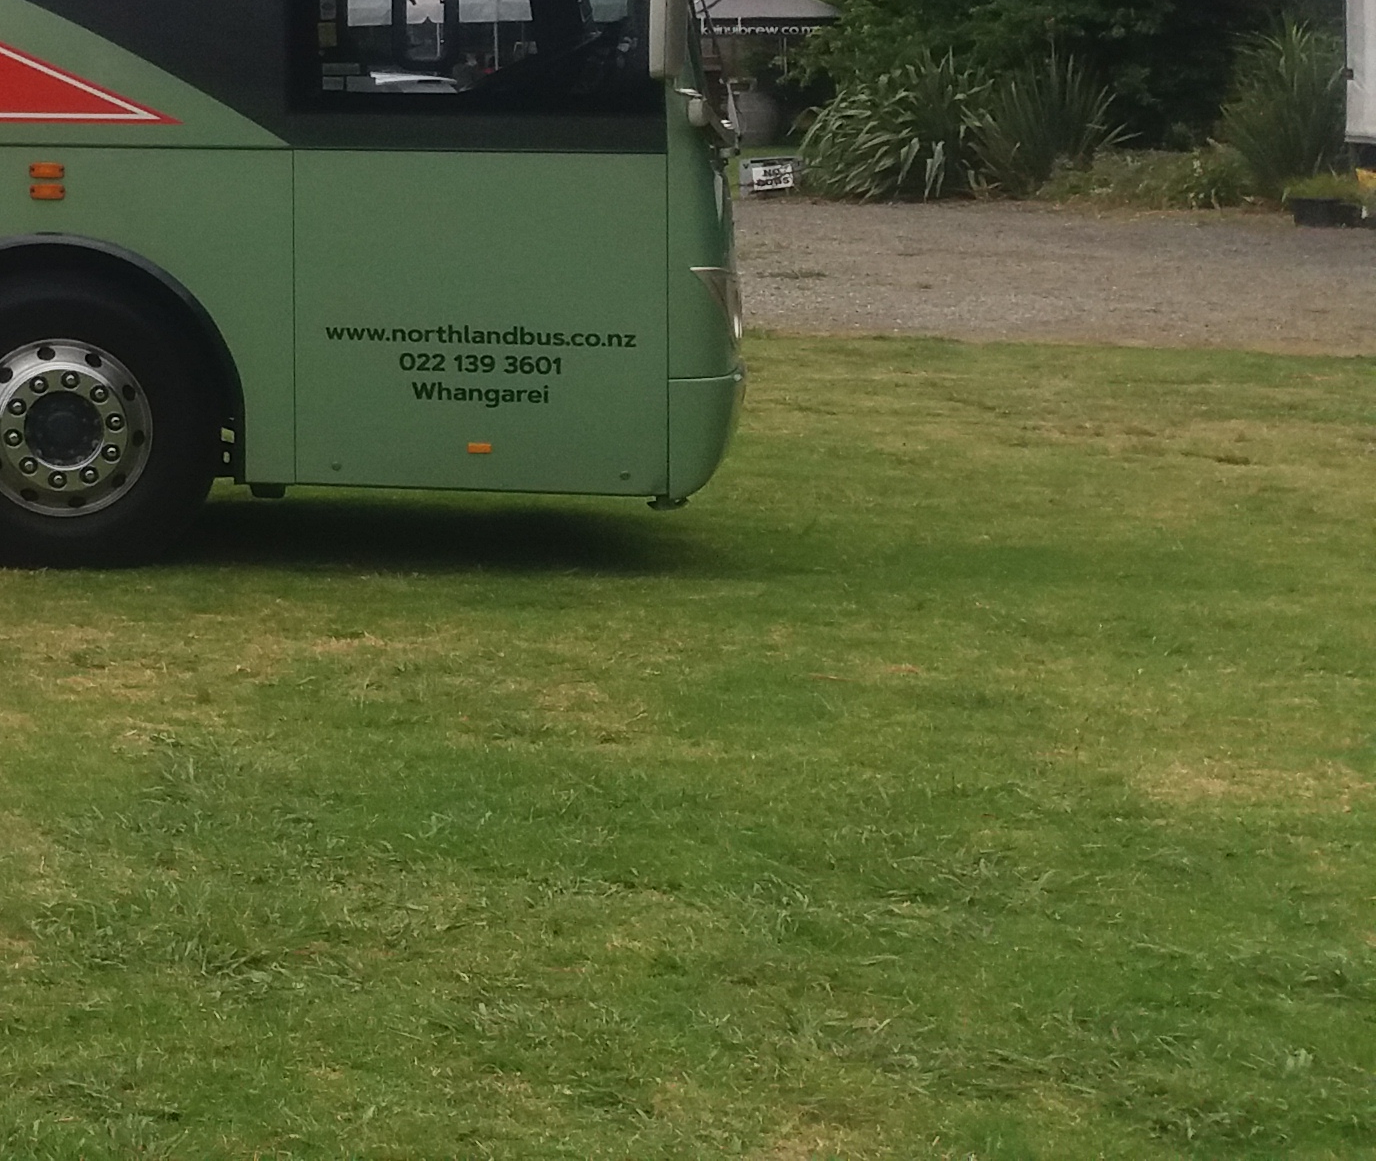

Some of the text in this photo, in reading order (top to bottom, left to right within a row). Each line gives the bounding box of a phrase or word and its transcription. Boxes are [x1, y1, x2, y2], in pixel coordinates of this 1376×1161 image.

[325, 323, 638, 349] www.northlandbus.co.nz
[398, 352, 563, 376] 022 139 3601
[410, 380, 550, 409] Whangarei
